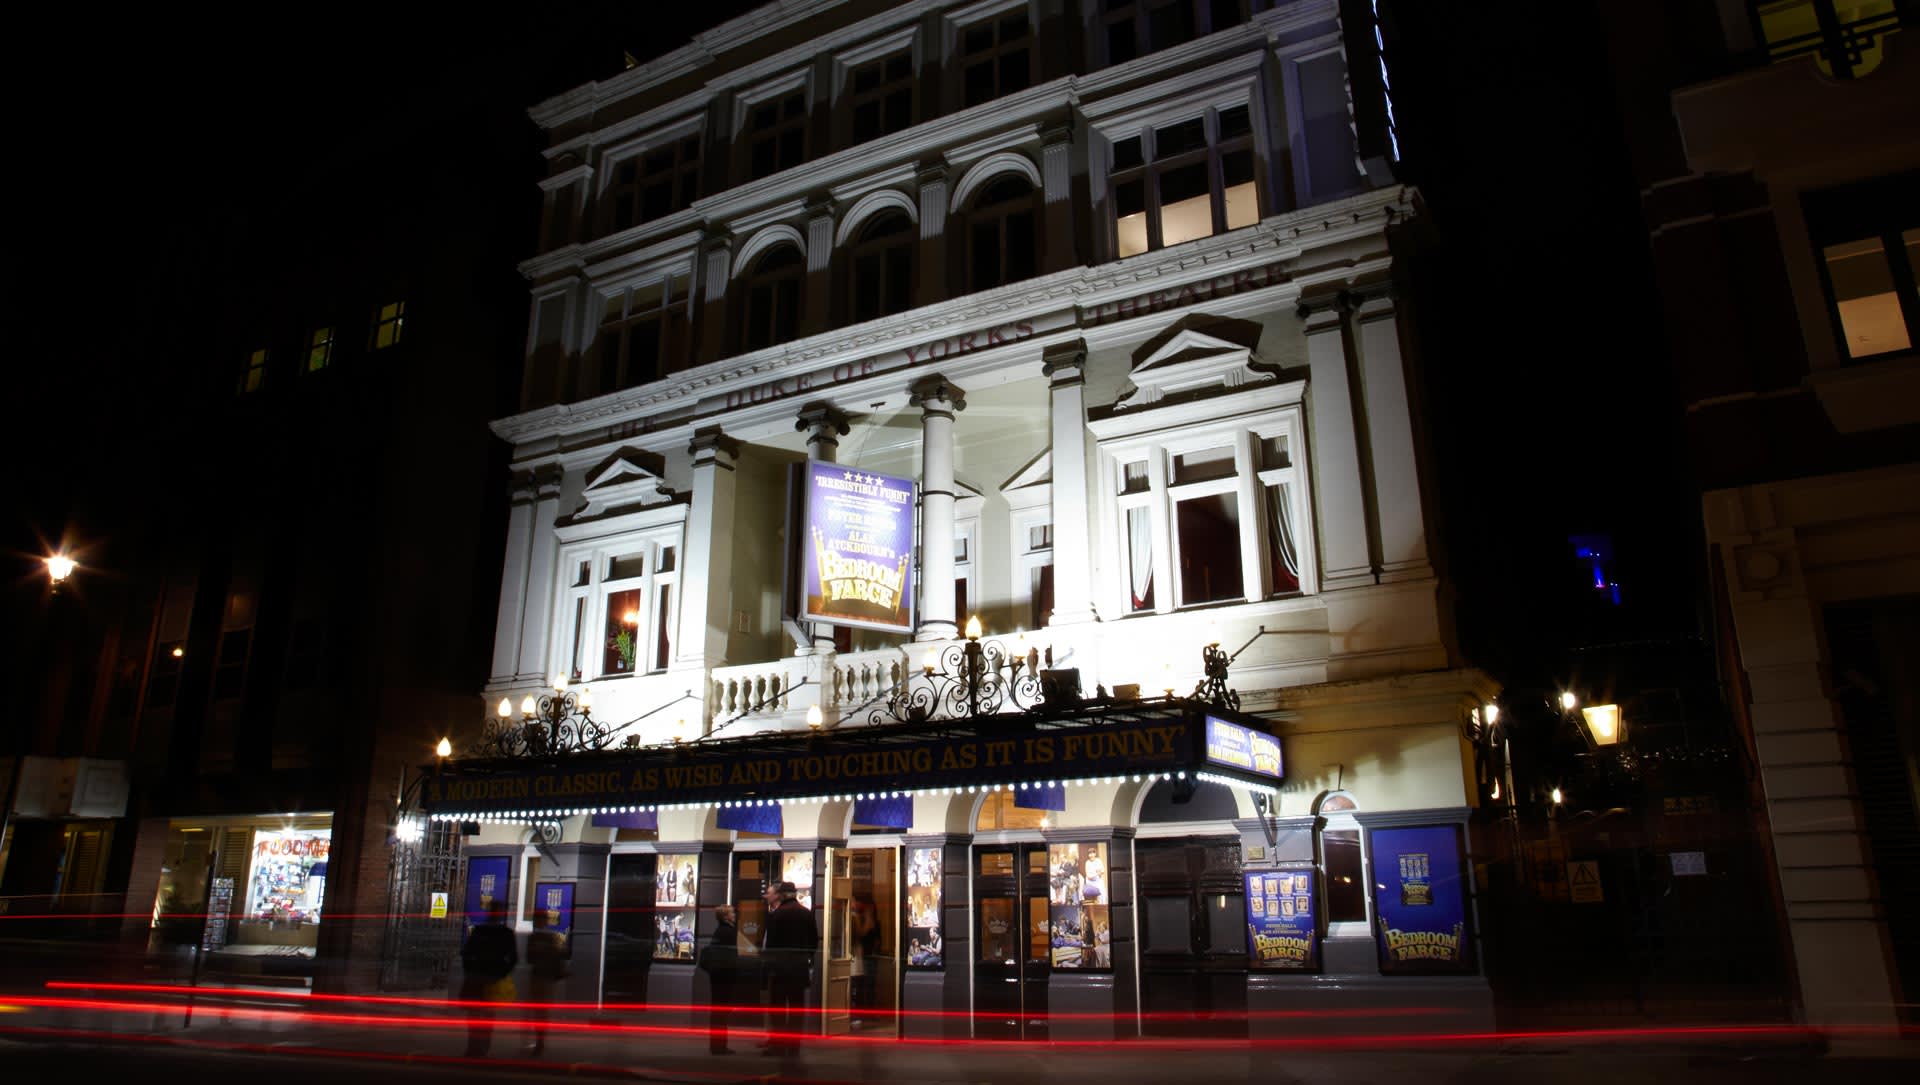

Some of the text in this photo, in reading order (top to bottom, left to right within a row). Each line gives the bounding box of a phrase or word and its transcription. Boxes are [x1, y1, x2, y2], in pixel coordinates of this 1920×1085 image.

[726, 373, 814, 411] DUKE
[833, 358, 876, 383] OF
[1088, 262, 1291, 325] THEATRE
[820, 550, 902, 592] BEDROOM
[831, 579, 893, 609] FARCE
[447, 775, 529, 802] MODERN
[631, 766, 659, 793] AS
[663, 763, 724, 789] WISE
[728, 758, 783, 785] AND
[786, 747, 931, 781] TOUCHING
[938, 743, 978, 770] AS
[984, 740, 1017, 767] IT
[1023, 737, 1056, 764] IS
[1255, 934, 1310, 951] BEDROOM
[1385, 928, 1458, 949] BEDROOM
[1264, 947, 1304, 960] FARCE
[1396, 945, 1451, 960] FARCE
